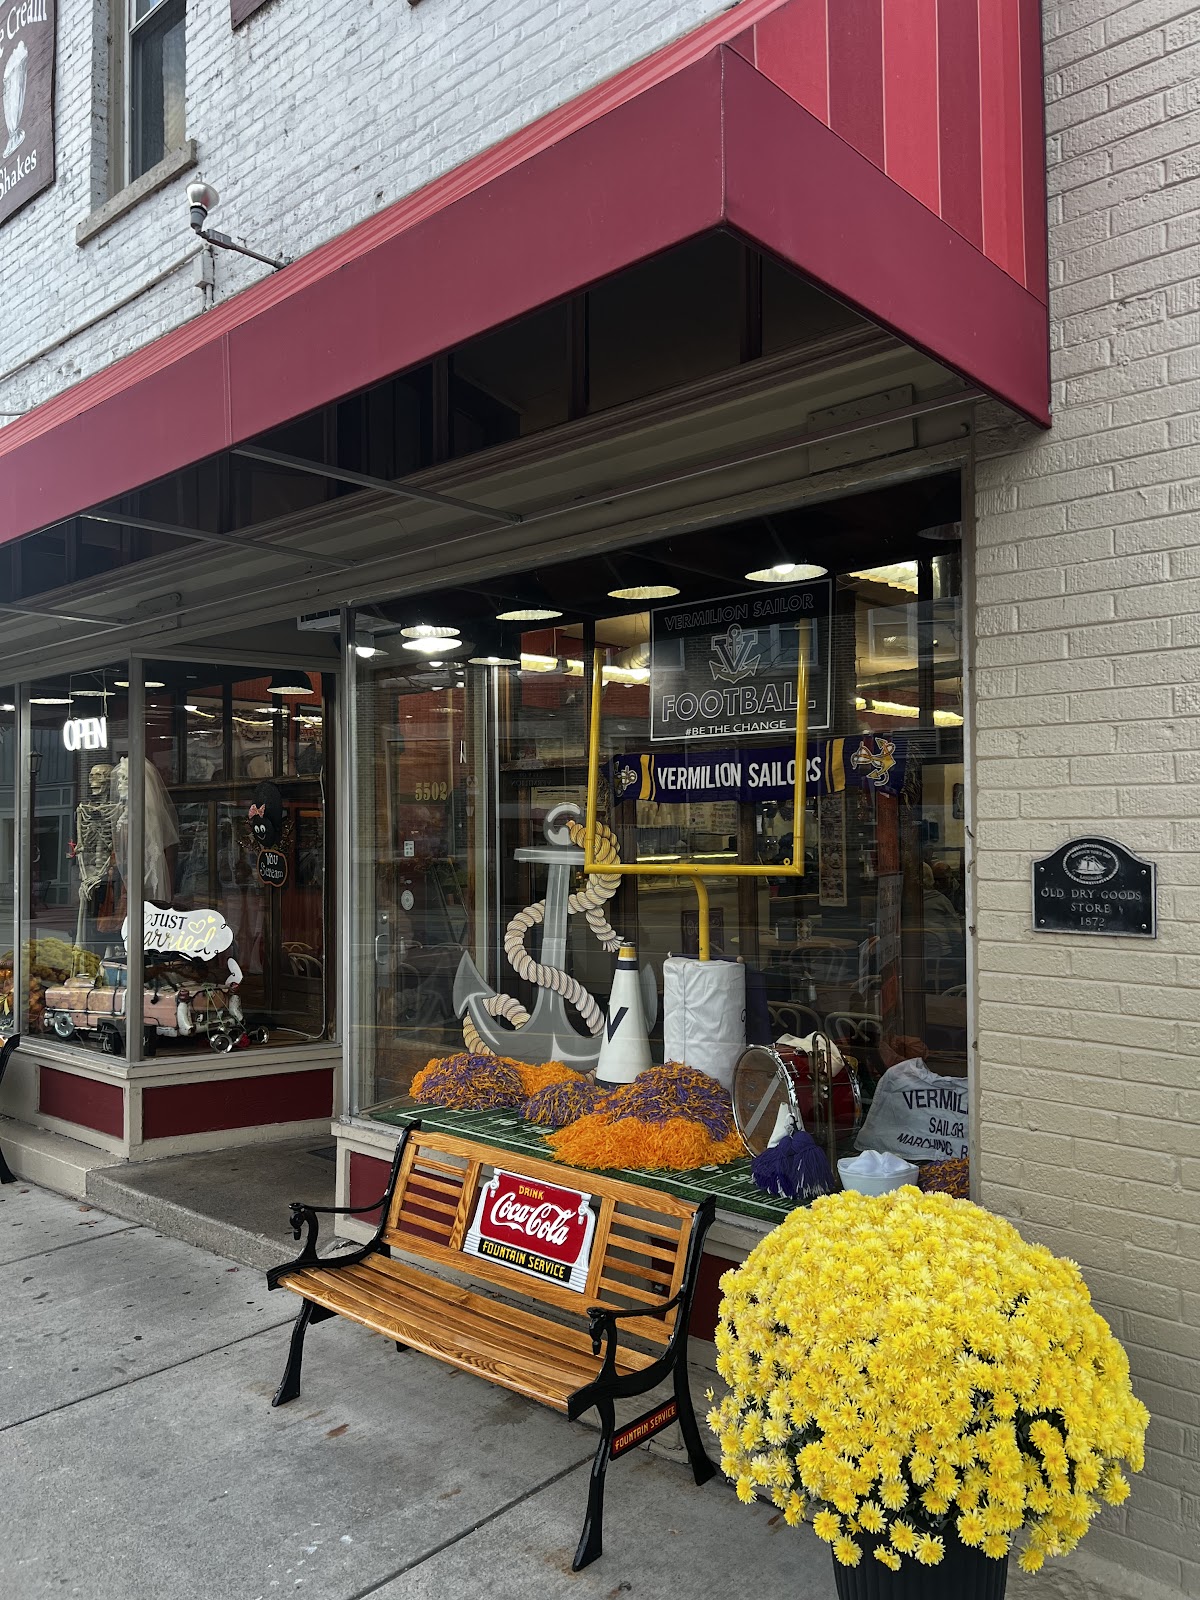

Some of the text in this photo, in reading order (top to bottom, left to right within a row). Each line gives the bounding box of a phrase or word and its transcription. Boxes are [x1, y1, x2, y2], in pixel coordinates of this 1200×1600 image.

[664, 593, 814, 631] VERMILION SAILOR
[662, 682, 816, 722] FOOTBAL
[63, 716, 108, 751] OPEN
[685, 719, 787, 737] #BE THE CHANGE
[657, 762, 742, 790] VERMILION
[415, 781, 448, 801] 5502
[1041, 887, 1141, 900] OLD DRY GOODS
[1071, 902, 1111, 914] STORE
[151, 913, 188, 930] JUST
[1080, 917, 1105, 927] 1872
[144, 926, 217, 955] arried
[902, 1088, 968, 1115] VERMIL
[929, 1116, 965, 1139] SAILOR
[897, 1132, 954, 1157] MARCHING
[518, 1185, 545, 1201] DRINK
[490, 1191, 576, 1246] Coca-Cola
[482, 1241, 566, 1279] FOUNTAIN SERVICE
[615, 1405, 676, 1450] FOUNTAIN SERVICE
